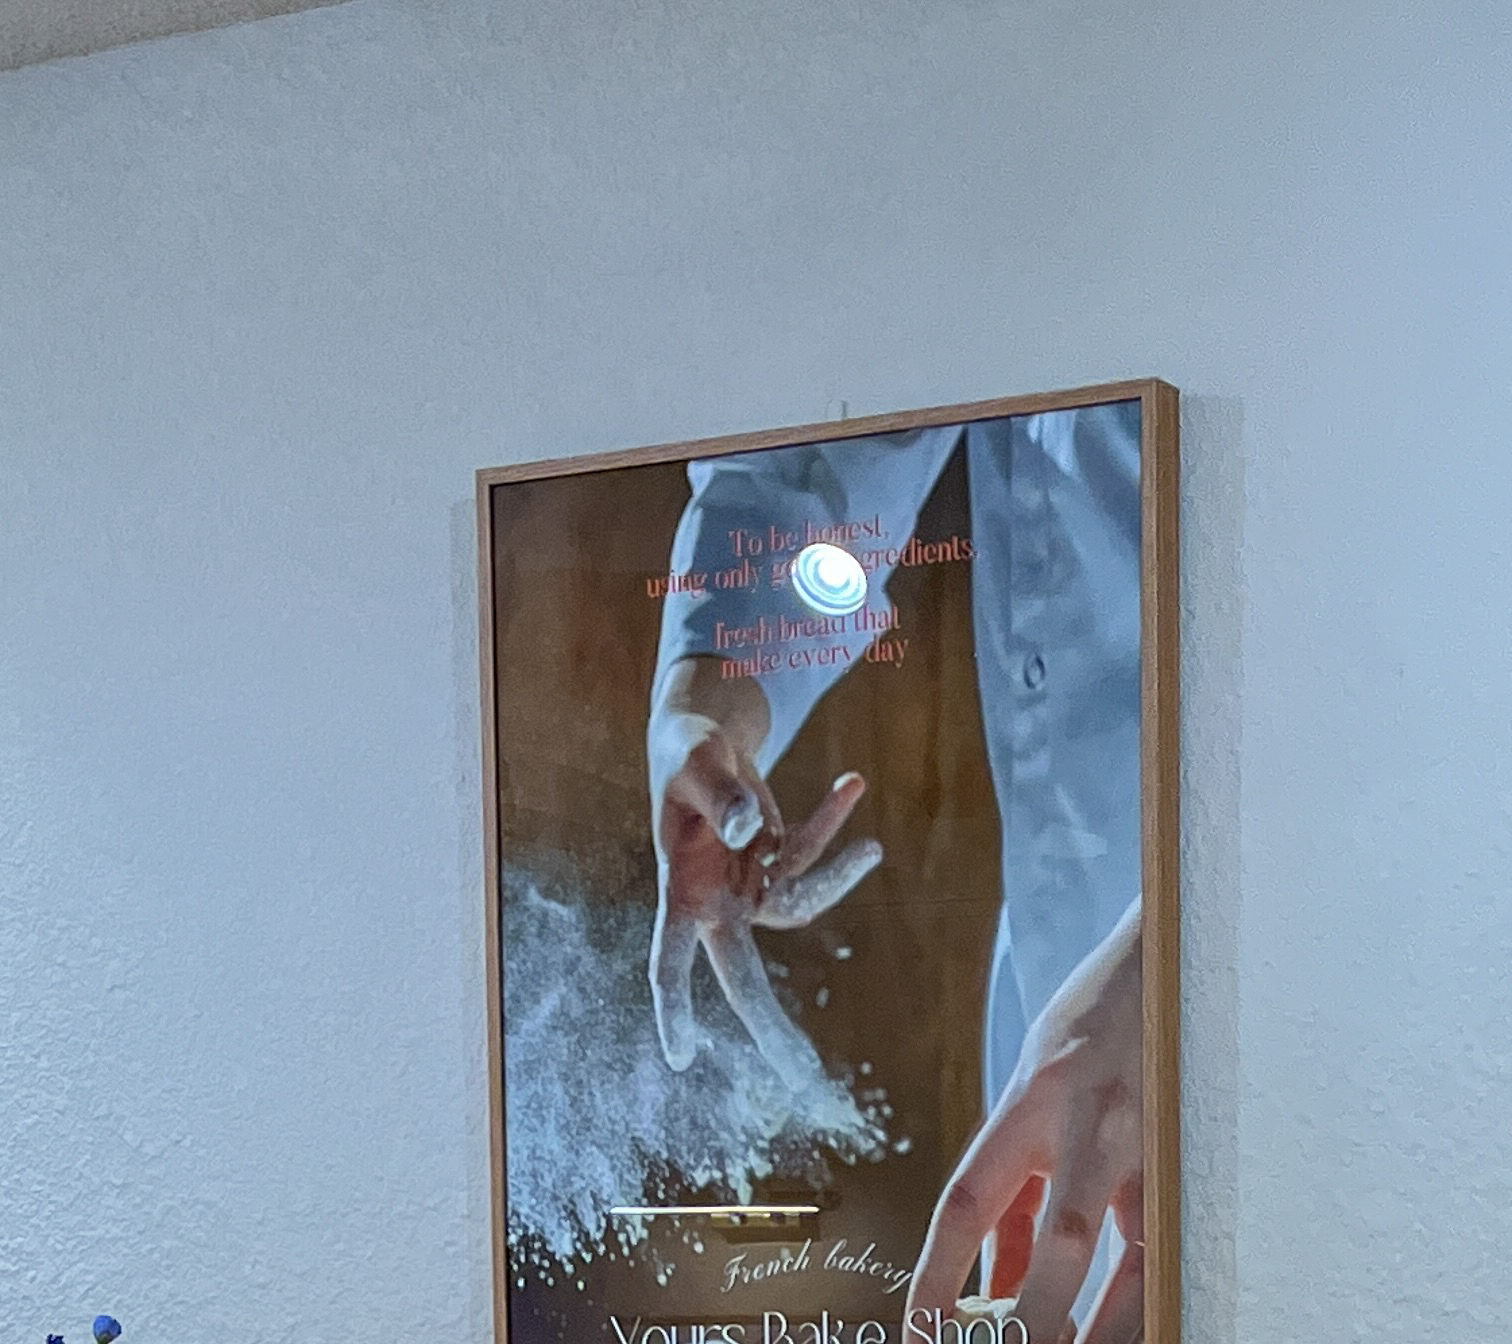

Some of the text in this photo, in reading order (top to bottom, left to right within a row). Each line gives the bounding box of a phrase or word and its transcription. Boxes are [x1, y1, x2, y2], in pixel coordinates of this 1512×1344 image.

[728, 528, 763, 558] To
[768, 525, 799, 554] be
[646, 569, 708, 600] using
[714, 558, 762, 593] only
[714, 602, 901, 650] fresh bread that
[720, 634, 910, 680] make every day
[719, 1238, 916, 1295] French bakery
